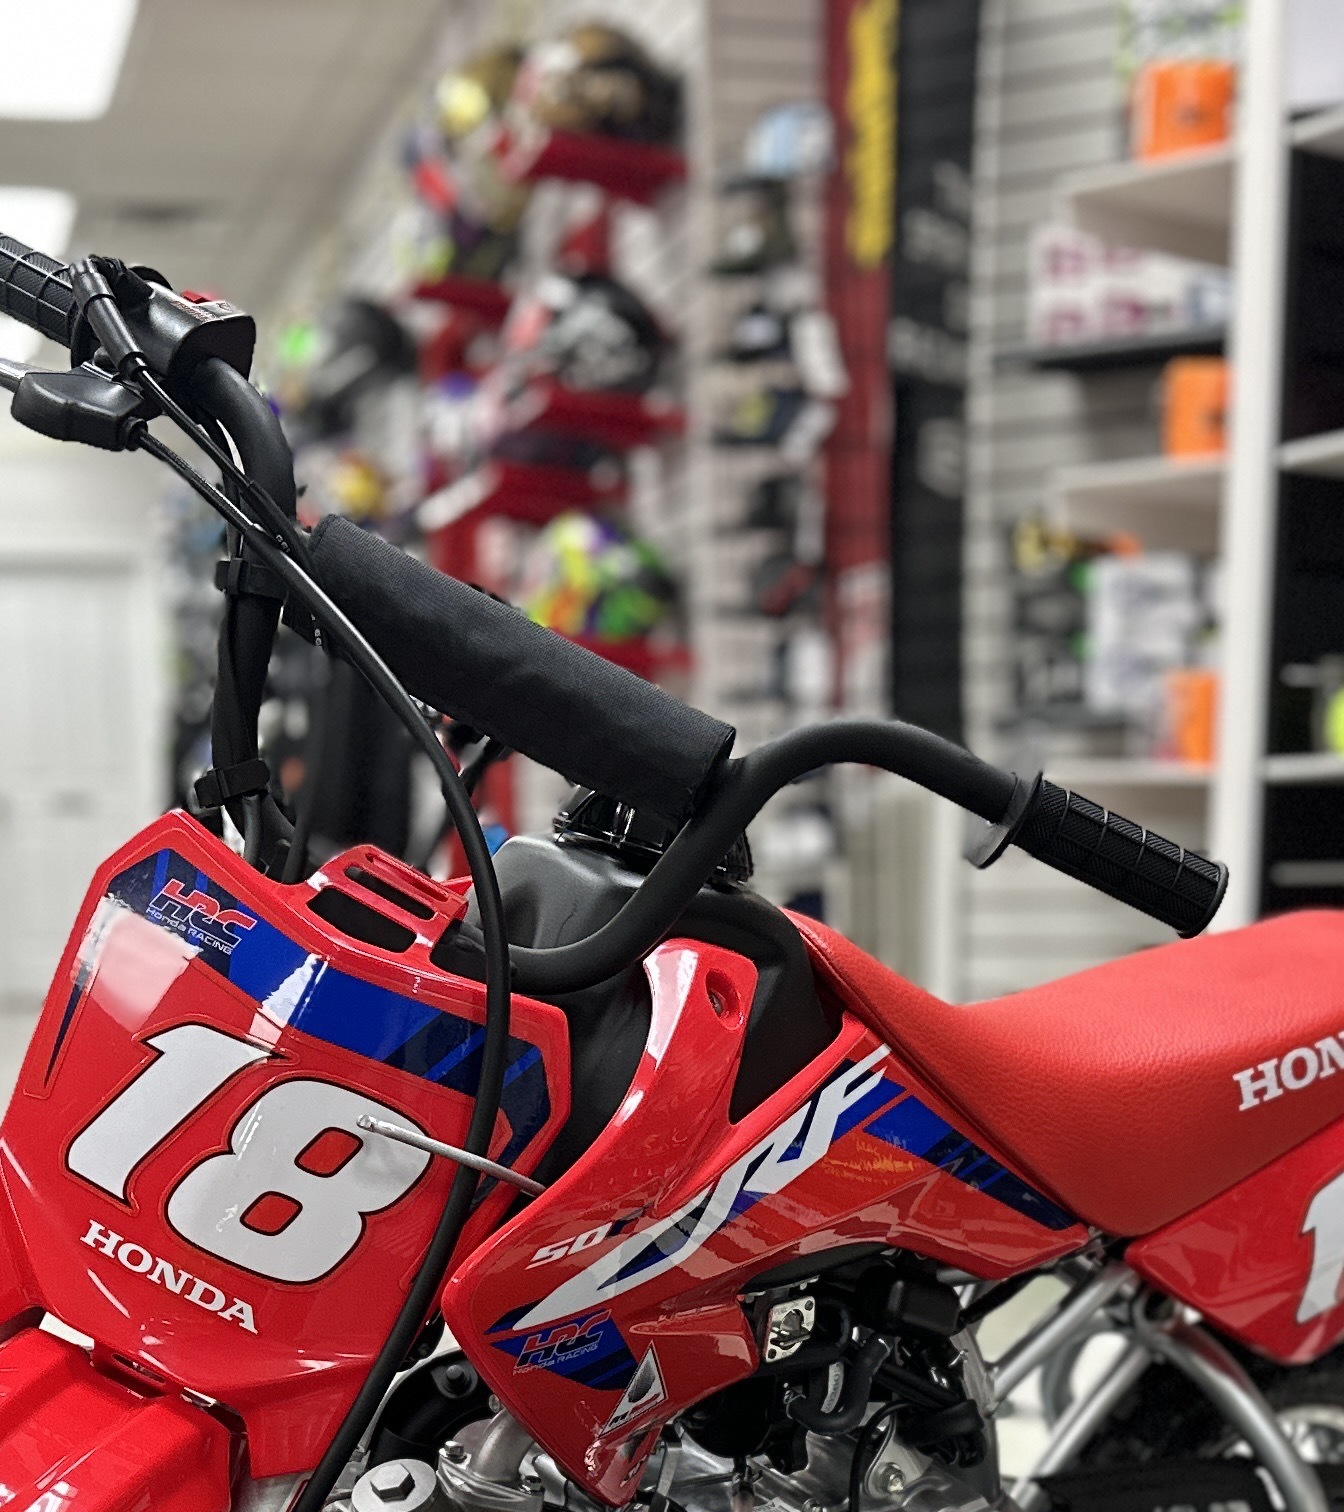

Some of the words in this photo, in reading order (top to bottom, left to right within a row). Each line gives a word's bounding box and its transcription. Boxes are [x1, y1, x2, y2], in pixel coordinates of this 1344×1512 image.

[146, 907, 187, 932] Honda
[187, 927, 233, 955] RACING
[149, 878, 257, 948] HRC
[65, 1024, 433, 1284] 18
[80, 1219, 258, 1334] HONDA
[515, 1309, 611, 1370] HRC
[557, 1341, 599, 1363] RACING
